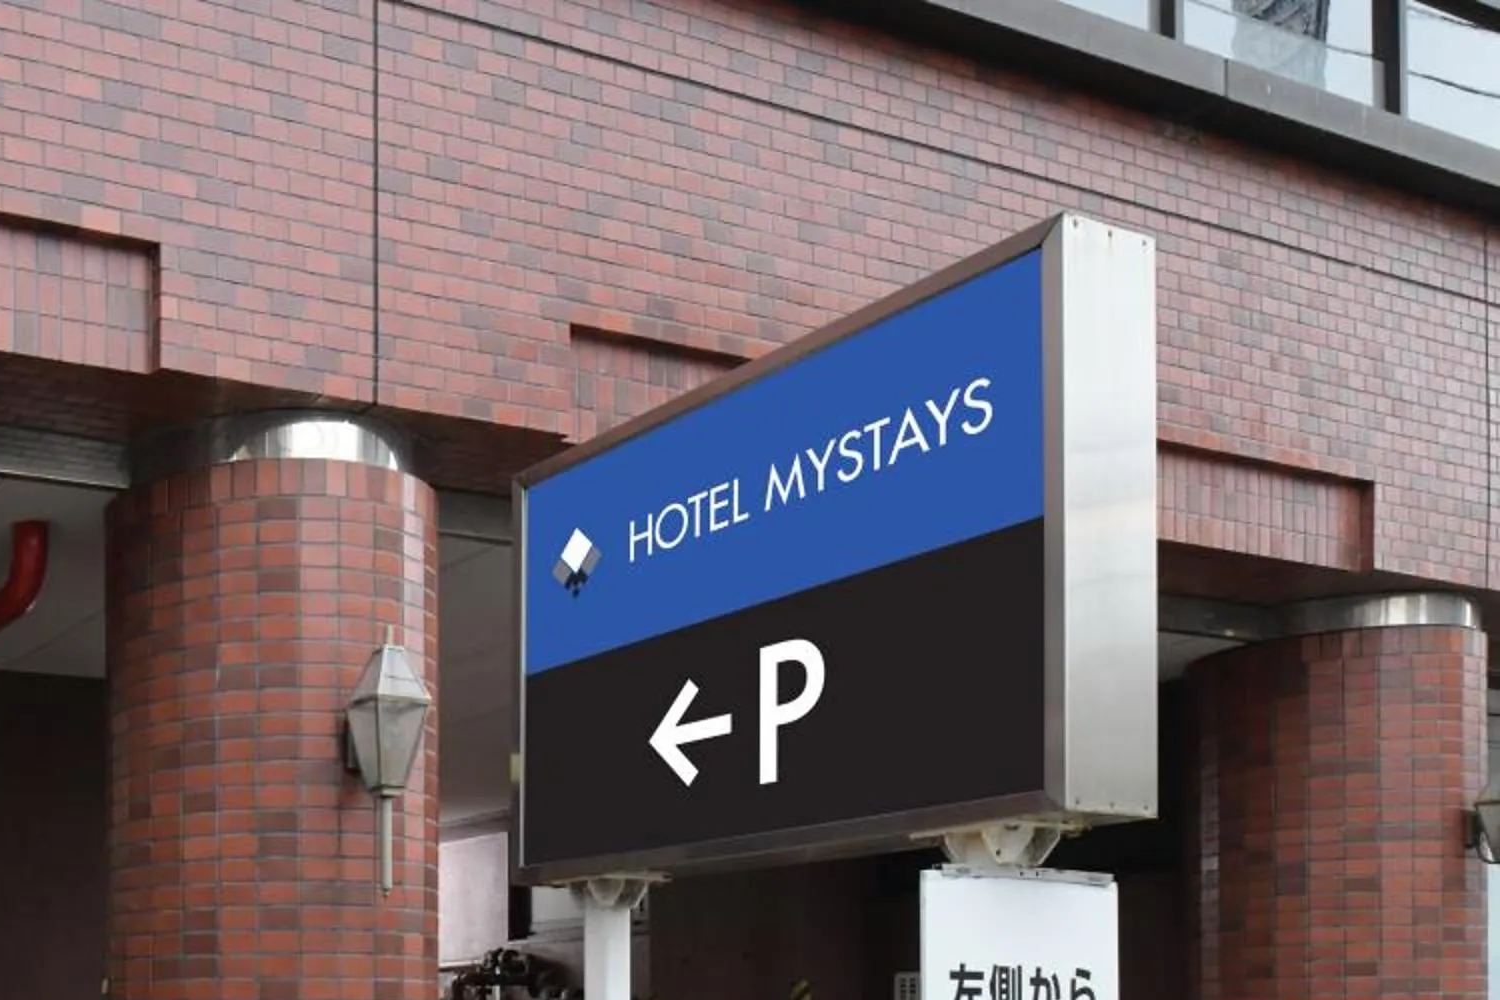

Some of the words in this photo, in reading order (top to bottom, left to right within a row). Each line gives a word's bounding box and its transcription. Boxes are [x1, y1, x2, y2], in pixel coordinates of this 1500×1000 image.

[630, 479, 748, 562] HOTEL
[765, 378, 992, 511] MYSTAYS
[760, 640, 824, 784] P
